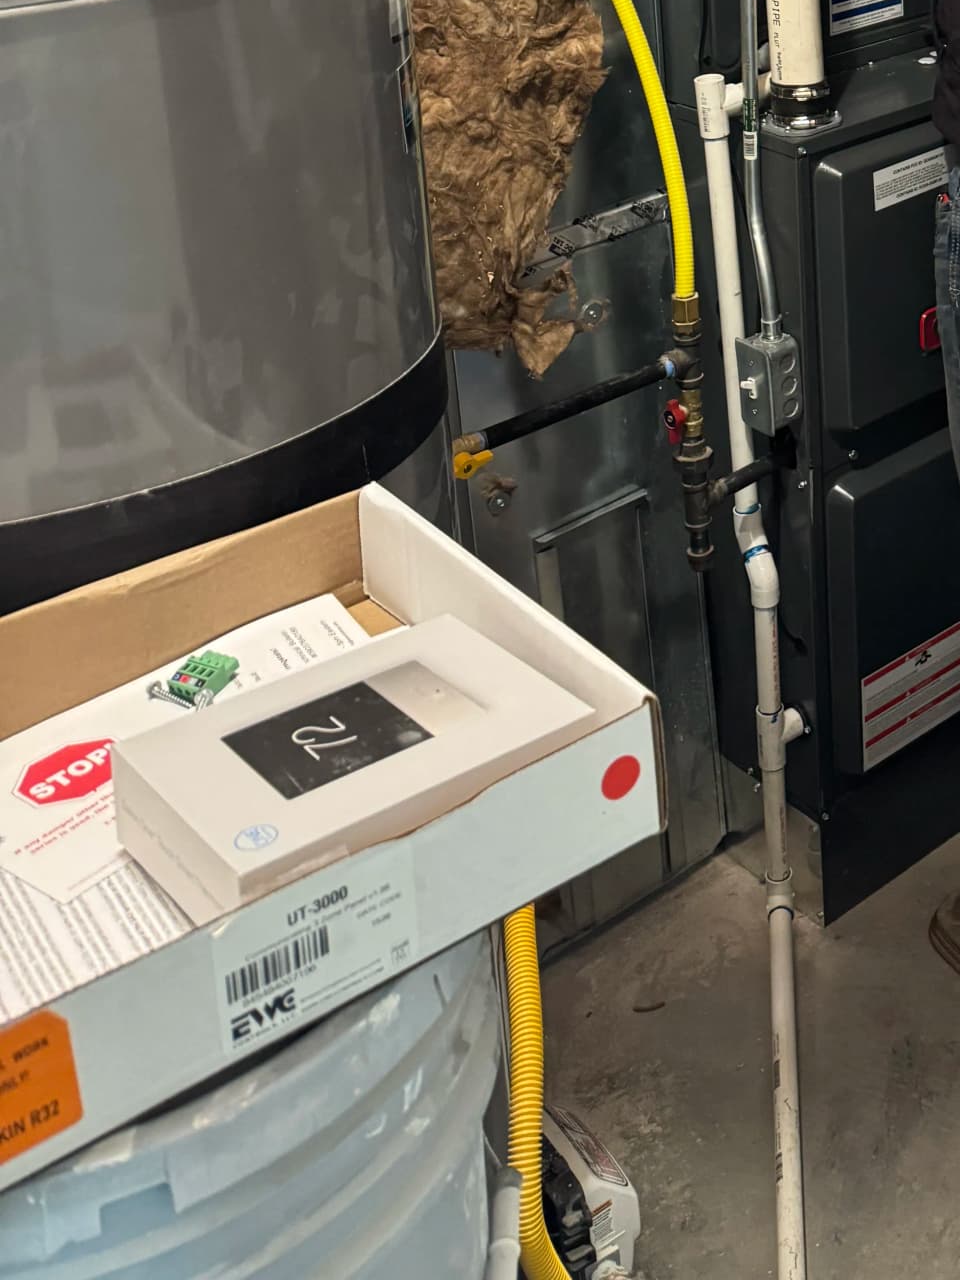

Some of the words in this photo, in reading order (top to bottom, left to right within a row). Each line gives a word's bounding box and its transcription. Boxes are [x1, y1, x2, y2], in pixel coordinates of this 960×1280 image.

[771, 0, 782, 27] PIPE
[287, 885, 348, 927] UT-3000
[30, 1099, 59, 1128] R32
